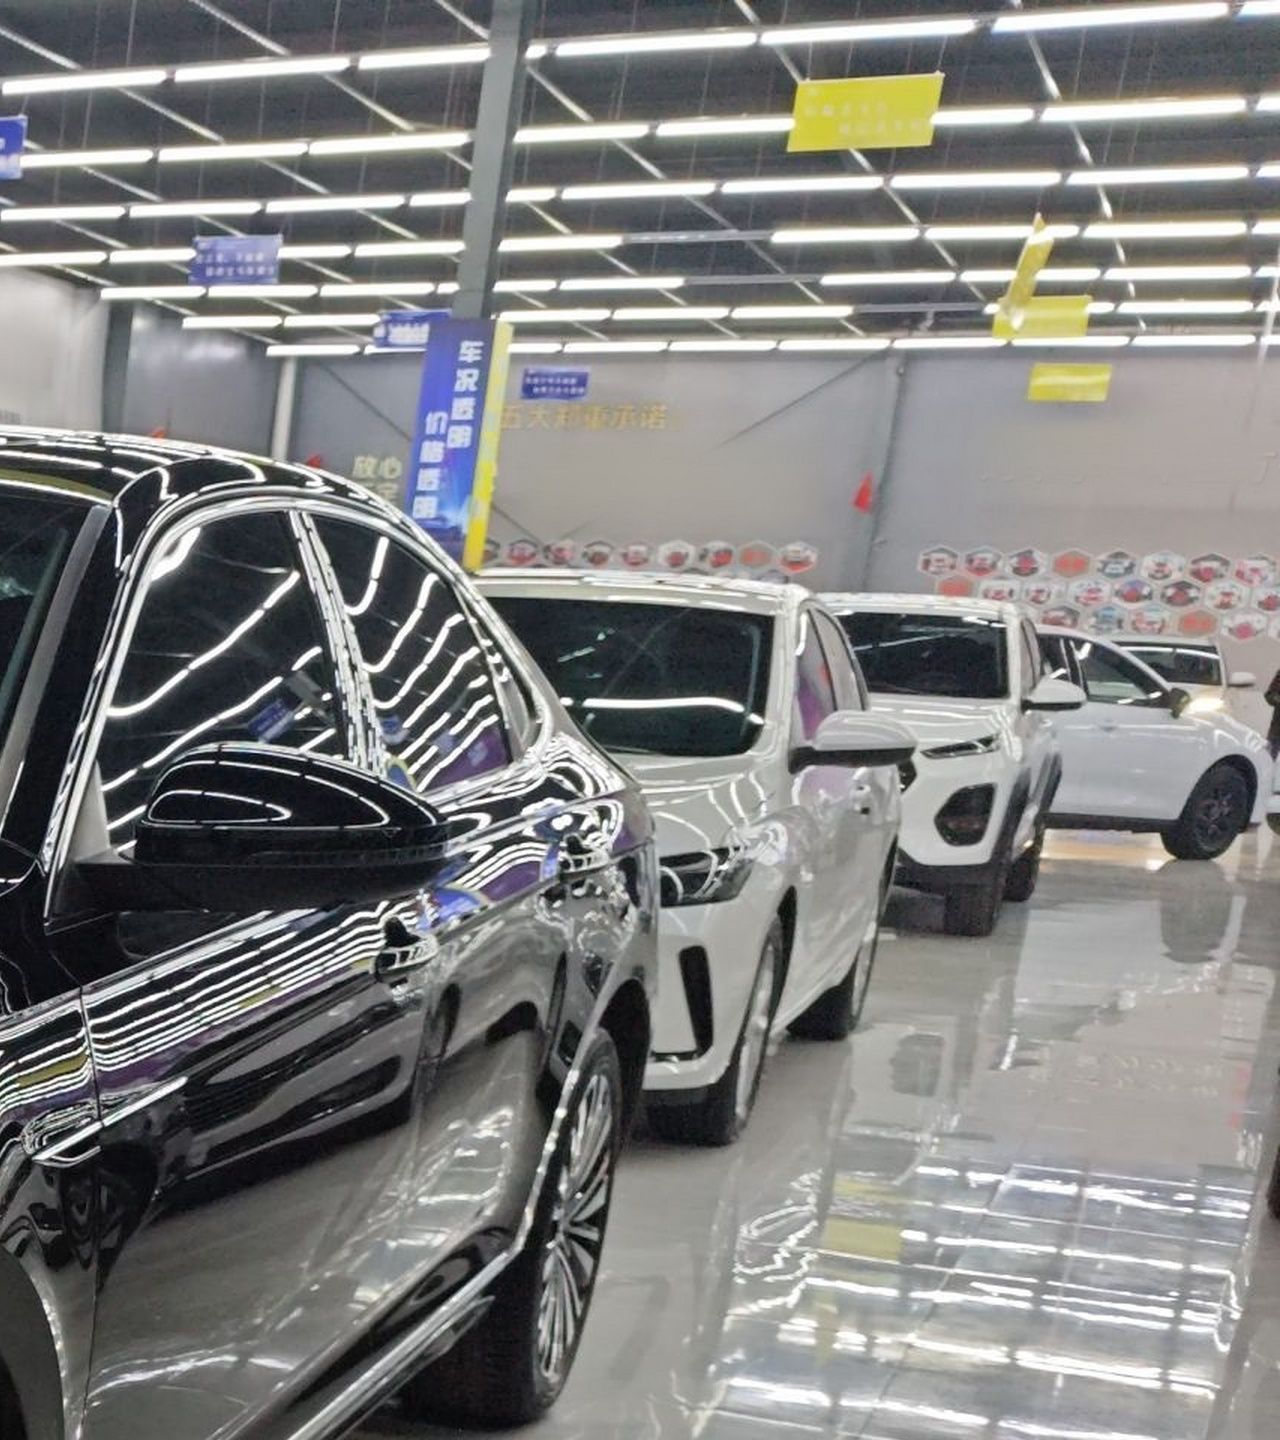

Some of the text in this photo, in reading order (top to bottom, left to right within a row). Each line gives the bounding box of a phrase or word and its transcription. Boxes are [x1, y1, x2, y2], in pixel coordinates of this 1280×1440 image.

[446, 341, 485, 448] 车况透明
[412, 411, 448, 519] 价格透明
